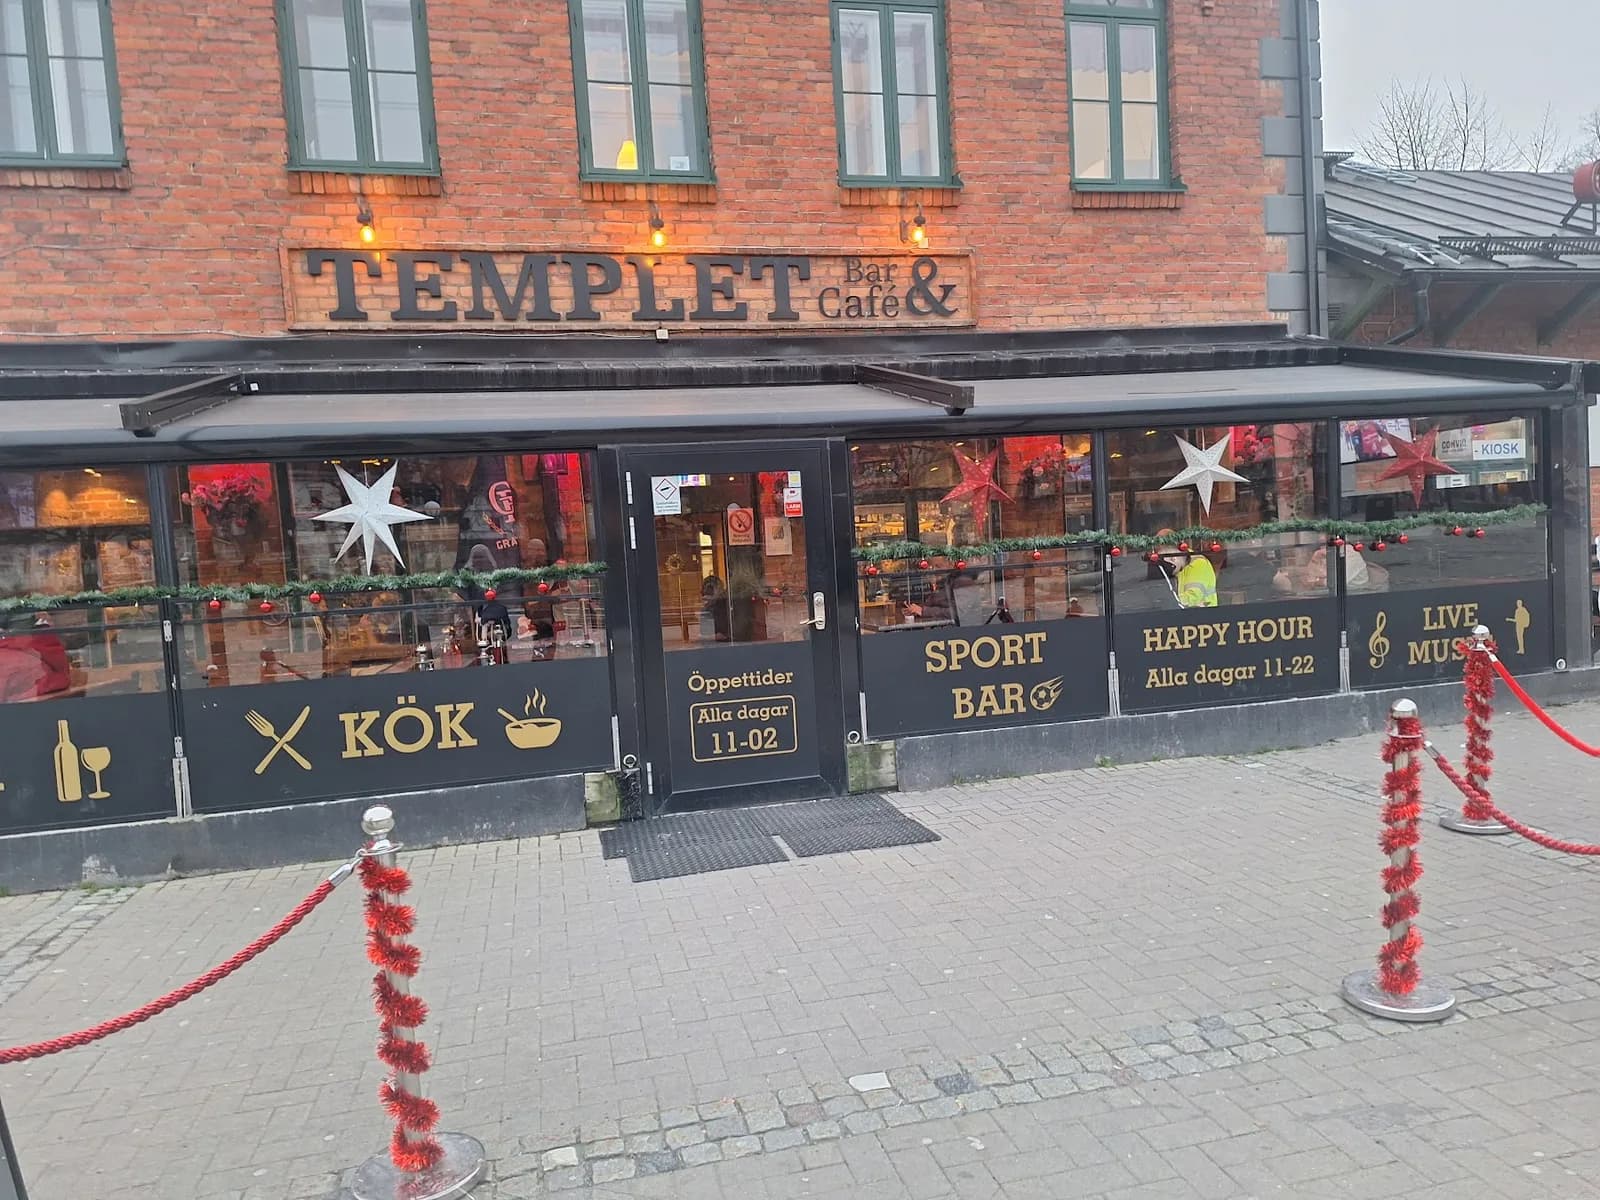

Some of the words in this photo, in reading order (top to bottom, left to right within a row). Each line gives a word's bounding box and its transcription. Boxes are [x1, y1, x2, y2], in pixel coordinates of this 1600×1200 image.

[307, 249, 812, 320] TEMPLET
[844, 256, 899, 283] Bar
[818, 284, 899, 319] Café
[906, 257, 958, 317] &
[1481, 443, 1519, 455] KIOSK
[1423, 603, 1478, 631] LIVE
[1144, 624, 1231, 653] HAPPY
[1237, 616, 1315, 645] HOUR
[924, 632, 1047, 674] SPORT
[687, 669, 794, 695] Öppettider
[1146, 668, 1188, 689] Alla
[1194, 664, 1257, 687] dagar
[1264, 655, 1315, 678] 11-22
[697, 707, 733, 724] Alla
[736, 702, 790, 722] dagar
[952, 682, 1027, 720] BAR
[339, 695, 479, 759] KÖK
[711, 726, 779, 755] 11-02
